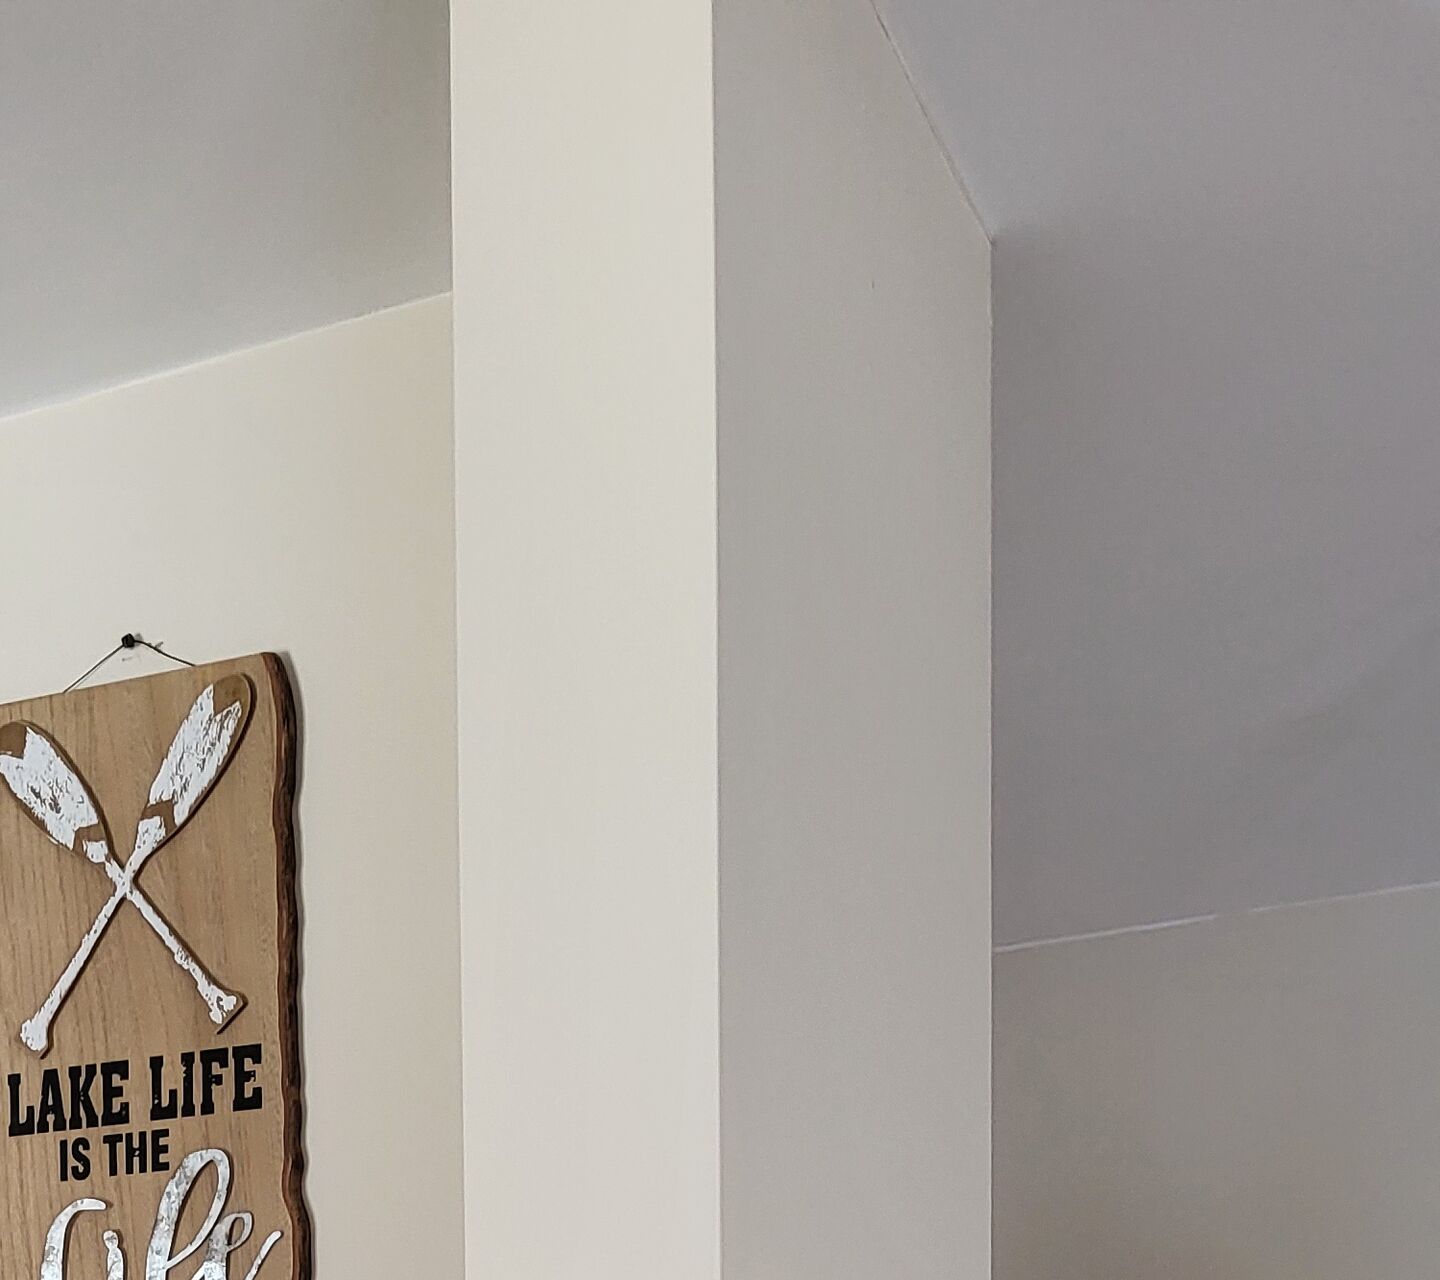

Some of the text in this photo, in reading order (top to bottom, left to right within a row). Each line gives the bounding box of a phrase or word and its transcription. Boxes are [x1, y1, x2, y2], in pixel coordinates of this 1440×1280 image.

[7, 1044, 263, 1139] LAKE LIFE
[59, 1128, 171, 1181] IS THE
